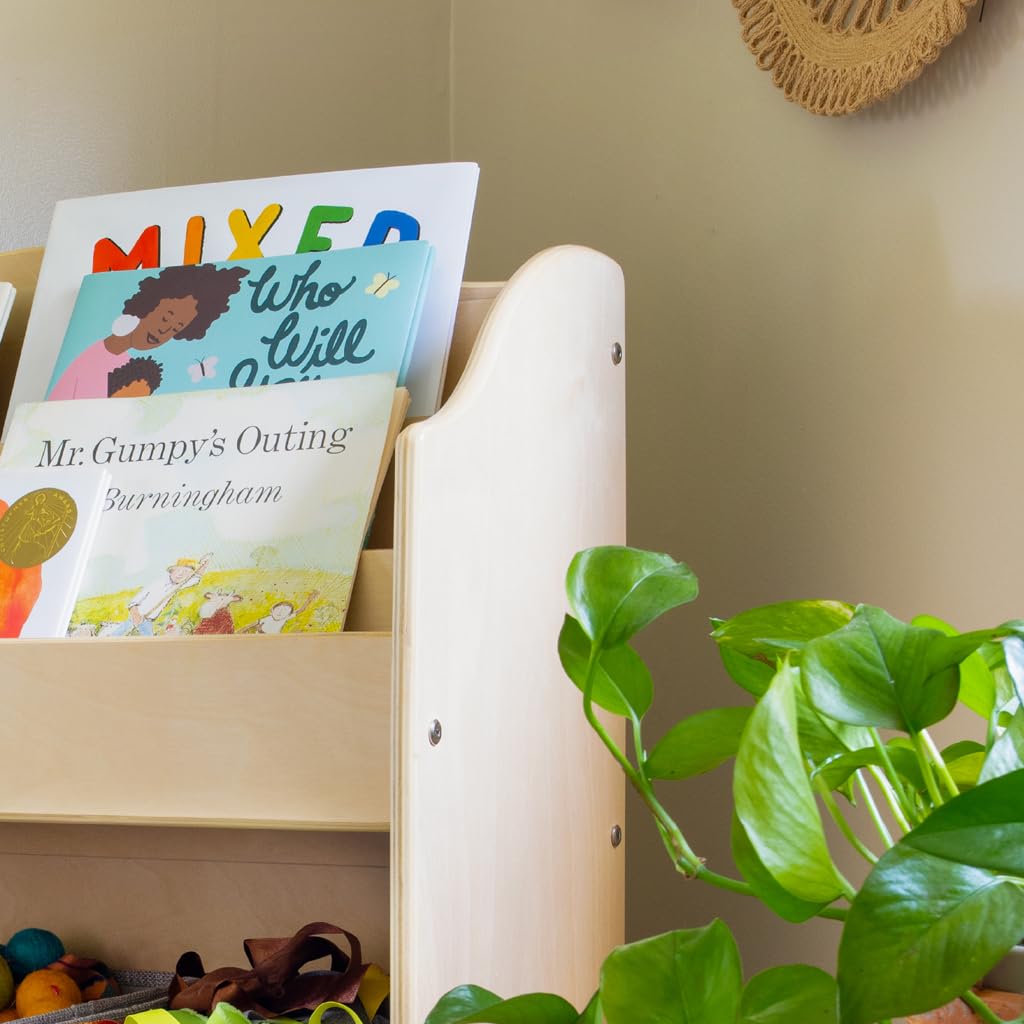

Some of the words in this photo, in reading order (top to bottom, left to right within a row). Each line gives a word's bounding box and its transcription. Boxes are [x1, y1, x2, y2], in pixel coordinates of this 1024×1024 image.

[247, 259, 357, 314] Who
[260, 311, 376, 374] Will
[33, 438, 84, 469] Mr.
[92, 428, 226, 467] Gumpy's
[235, 420, 354, 455] Outing
[102, 480, 284, 513] Burningham
